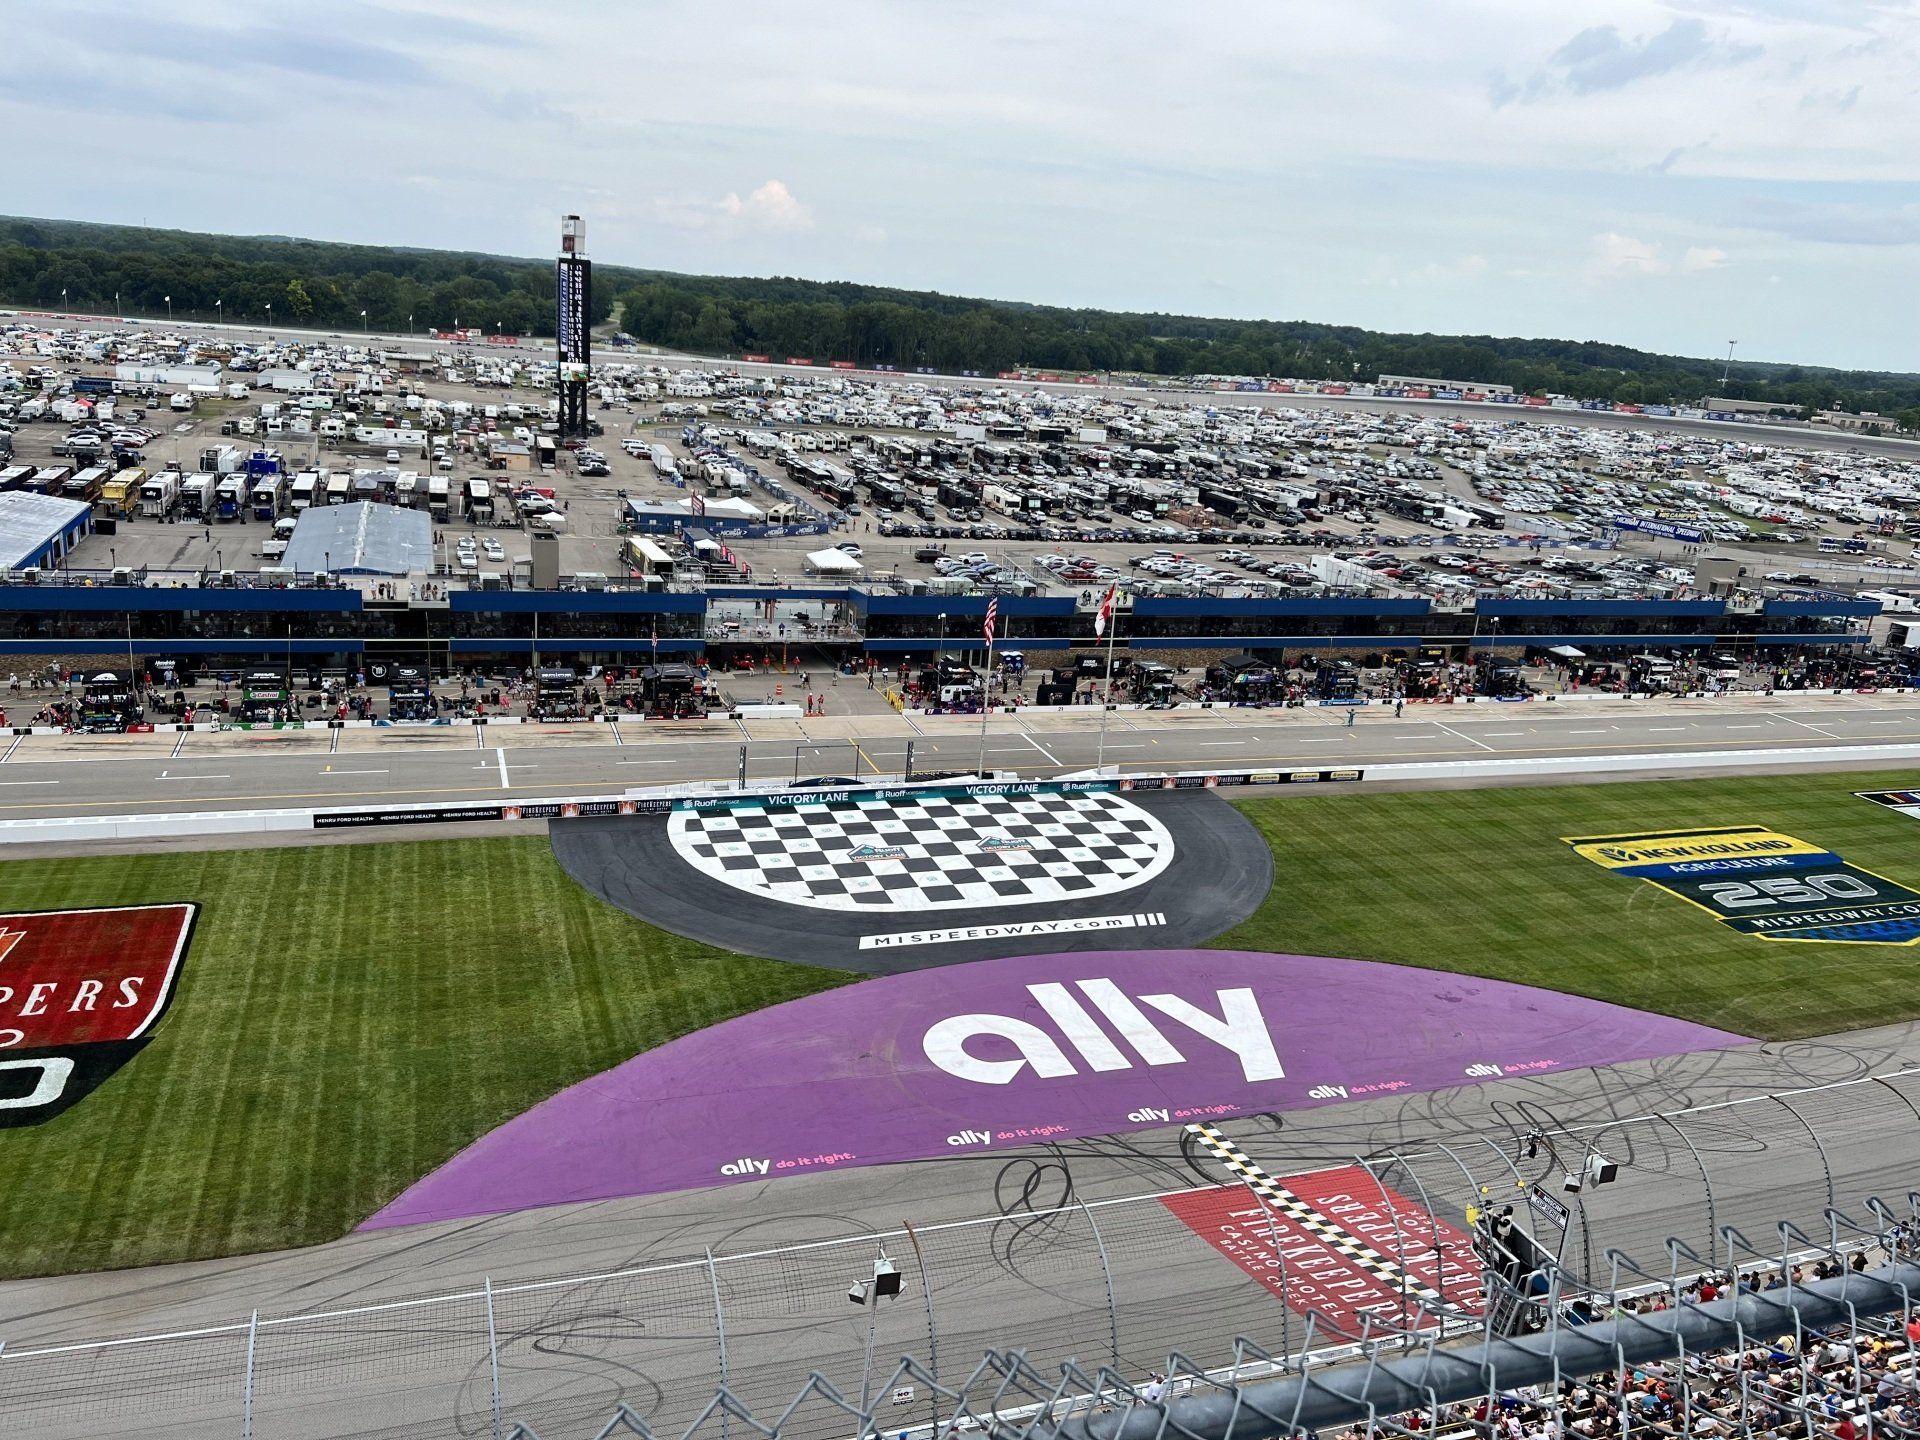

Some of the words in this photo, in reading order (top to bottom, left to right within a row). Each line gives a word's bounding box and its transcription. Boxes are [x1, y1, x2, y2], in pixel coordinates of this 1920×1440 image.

[1640, 520, 1676, 534] INTERNATIONAL
[885, 790, 906, 798] Ruoff
[966, 785, 1010, 795] VICTORY
[1012, 783, 1039, 793] LANE
[1071, 782, 1091, 790] Ruoff
[694, 799, 717, 807] Ruoff
[768, 794, 817, 805] VICTORY
[820, 792, 849, 802] LANE
[1639, 846, 1684, 859] NEW
[1698, 840, 1793, 856] HOLLAND
[1669, 857, 1794, 873] AGRICULTURE
[1699, 874, 1878, 908] 250
[875, 918, 1122, 946] MISPEEDWAY.com
[923, 978, 1285, 1084] ally
[1464, 1061, 1504, 1077] ally
[1505, 1064, 1519, 1072] do
[1520, 1062, 1530, 1070] it
[1532, 1060, 1560, 1070] right.
[1308, 1084, 1348, 1100] ally
[1351, 1086, 1367, 1094] do
[1368, 1083, 1378, 1092] it
[1380, 1080, 1411, 1092] right.
[1128, 1107, 1169, 1123] ally
[1174, 1109, 1191, 1118] do
[1193, 1107, 1205, 1116] it
[1207, 1104, 1240, 1116] right.
[947, 1129, 991, 1146] ally
[997, 1131, 1014, 1140] do
[1016, 1129, 1028, 1138] it
[1030, 1125, 1069, 1136] right.
[720, 1158, 770, 1176] ally
[776, 1160, 796, 1169] do
[798, 1157, 812, 1167] it
[814, 1153, 856, 1166] right.
[1542, 1196, 1562, 1213] NASCAR
[1546, 1206, 1562, 1222] SERIES
[1219, 1240, 1264, 1271] BATTLE
[1266, 1275, 1309, 1306] CREEK
[1220, 1225, 1280, 1268] CASINO
[1287, 1276, 1346, 1318] HOTEL
[1228, 1207, 1416, 1326] FIREKEEPERS
